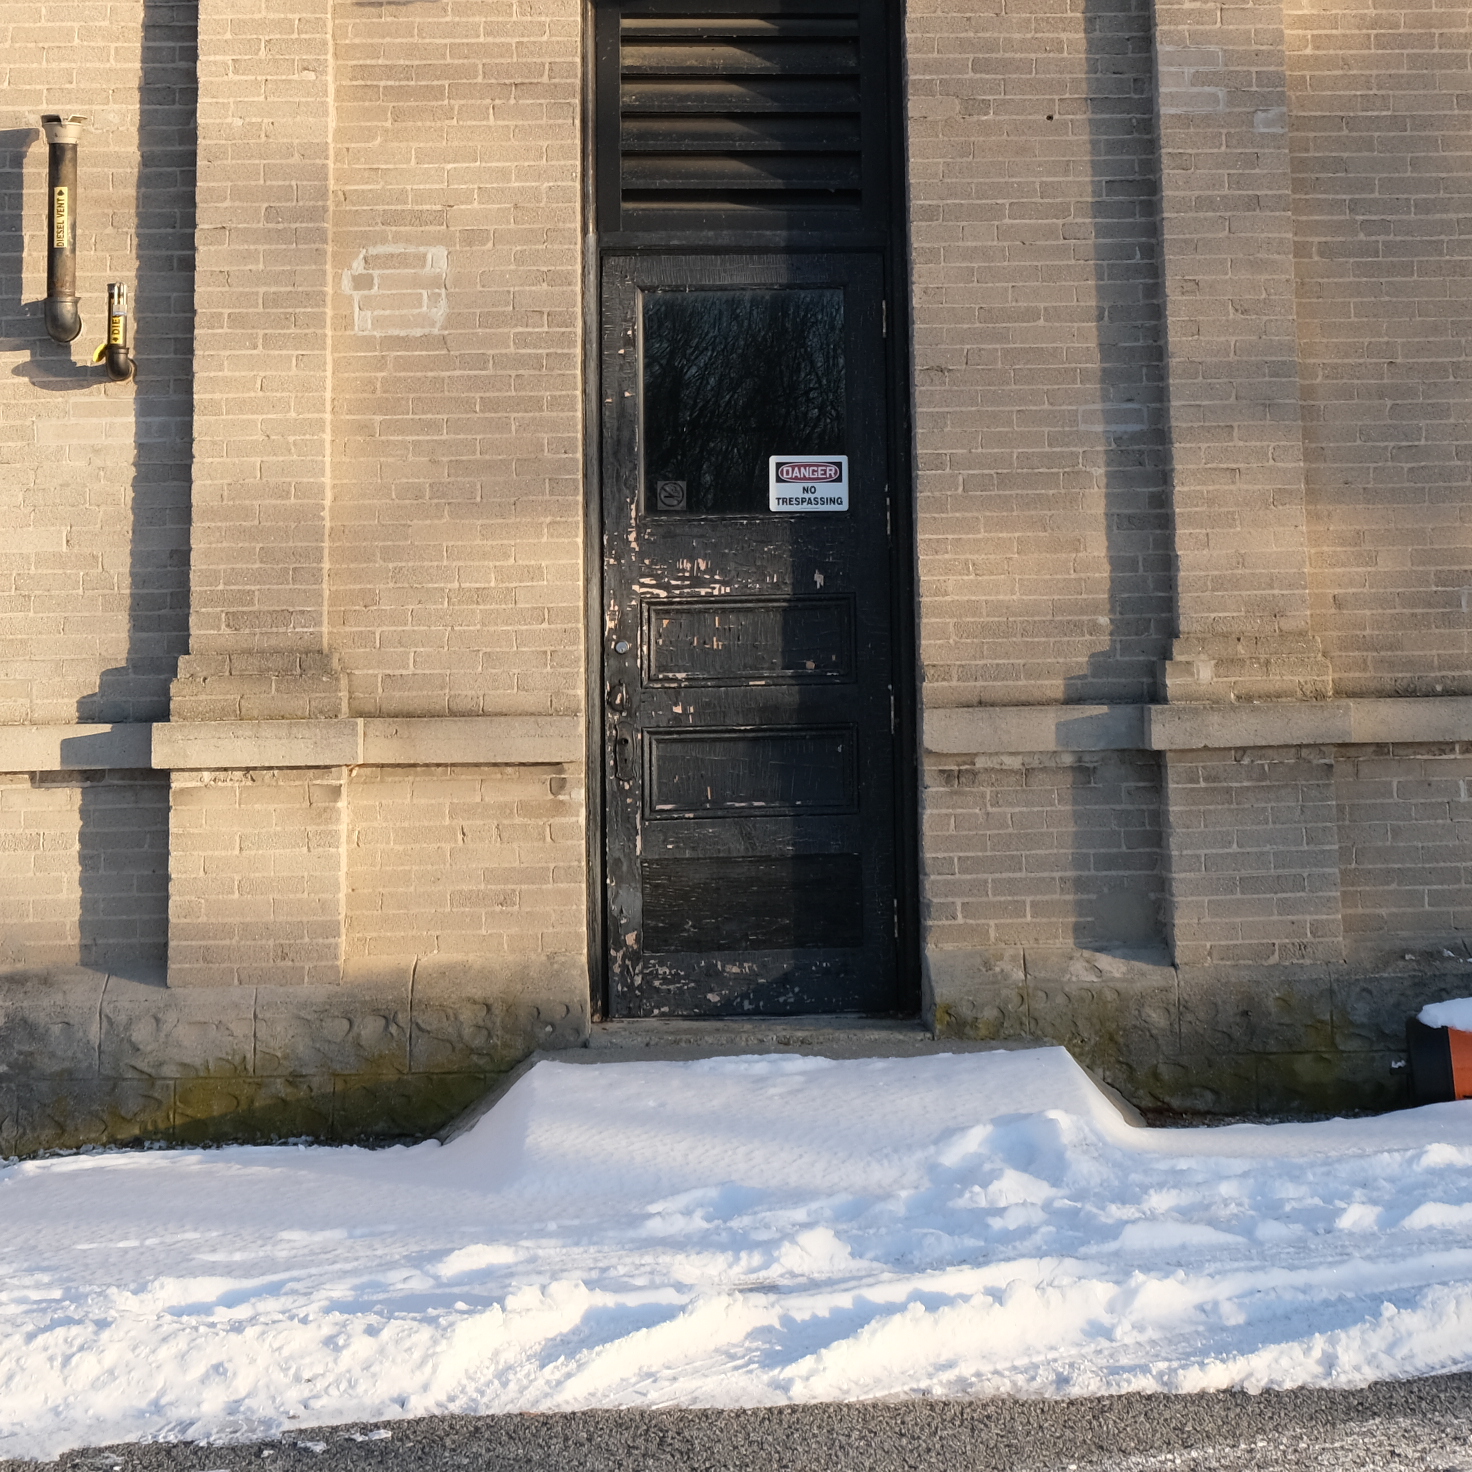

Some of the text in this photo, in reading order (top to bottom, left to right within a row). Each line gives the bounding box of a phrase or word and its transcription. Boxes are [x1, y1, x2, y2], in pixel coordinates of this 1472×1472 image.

[56, 197, 65, 247] DIESEL VENT
[783, 466, 835, 478] DANGER
[802, 485, 817, 495] NO
[775, 496, 844, 506] TRESPASSING
